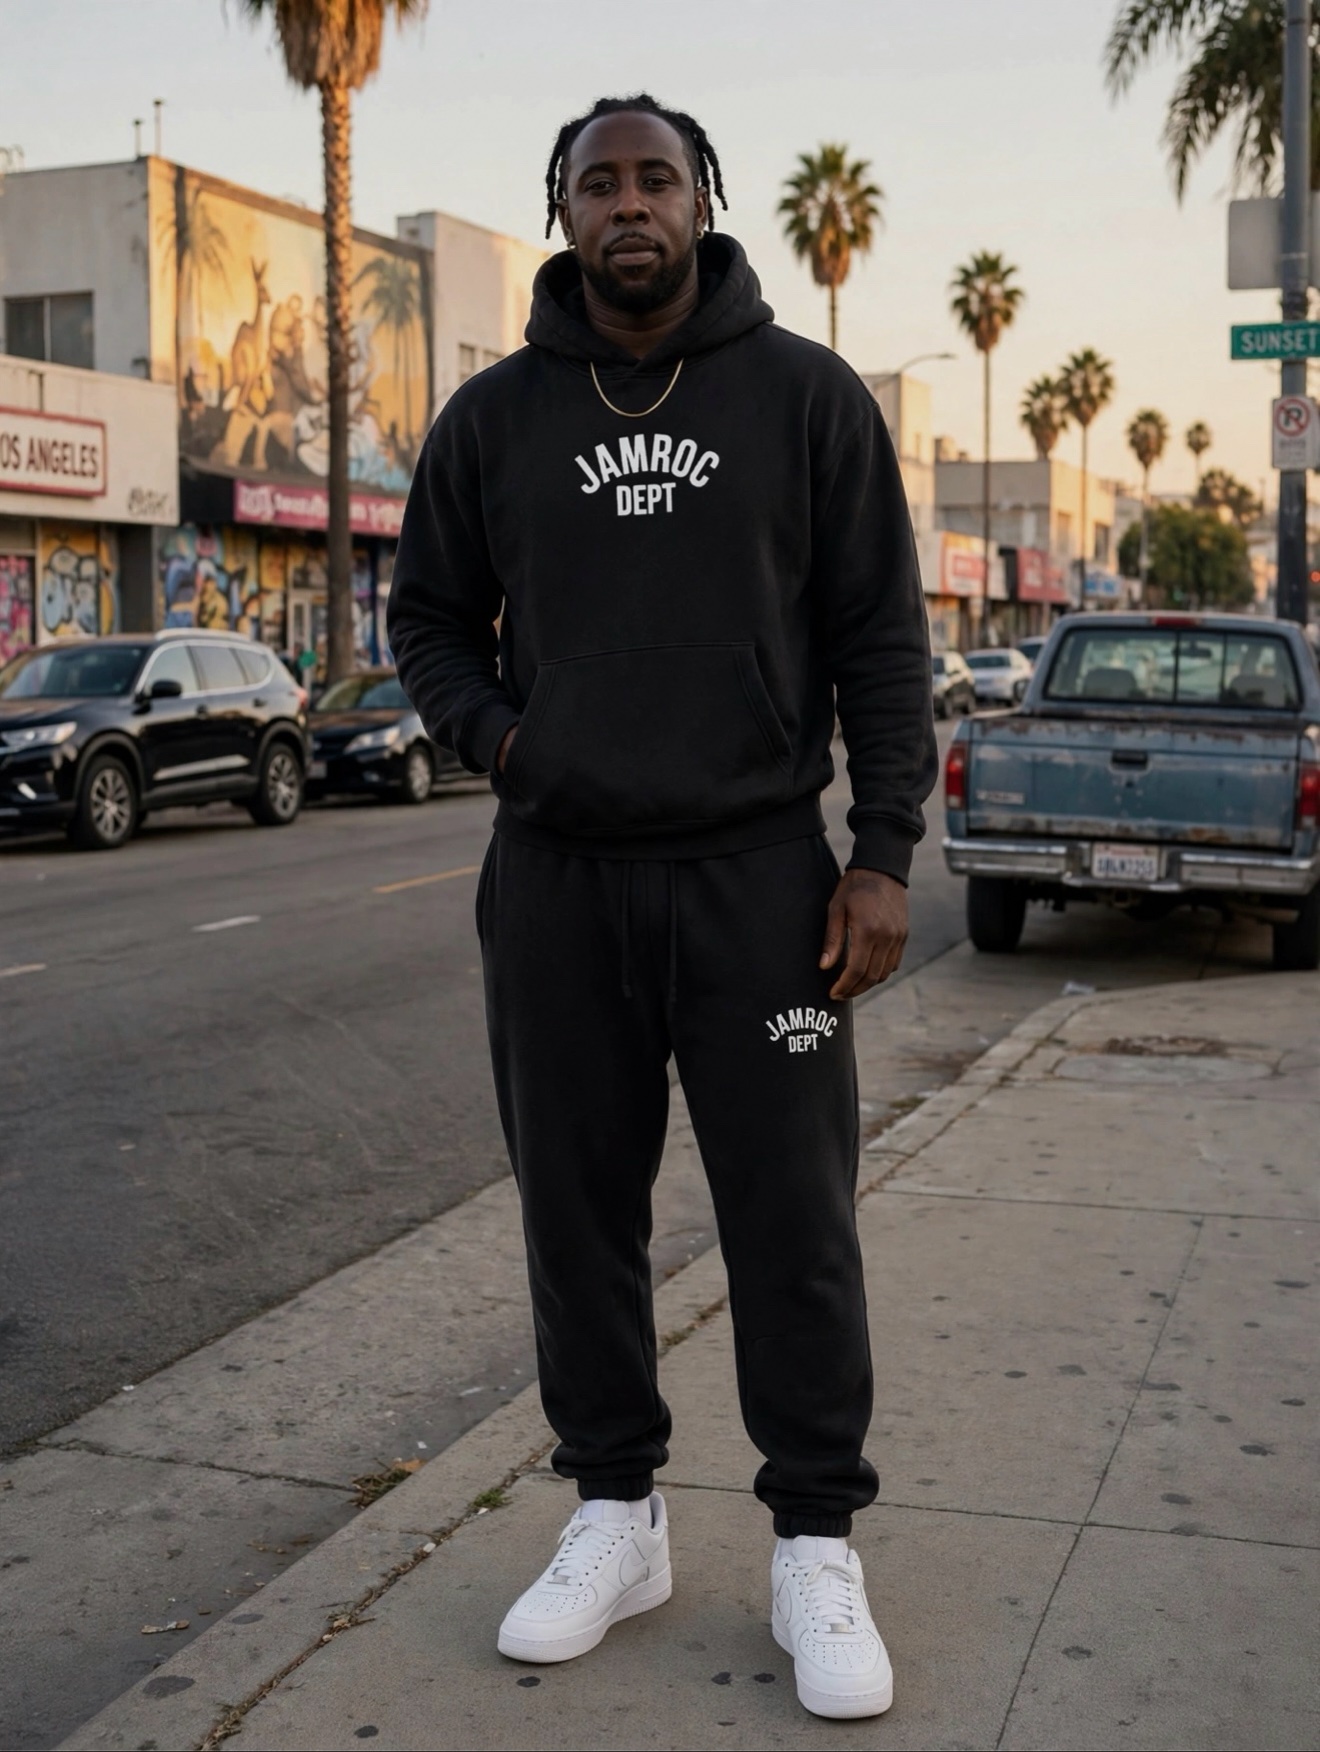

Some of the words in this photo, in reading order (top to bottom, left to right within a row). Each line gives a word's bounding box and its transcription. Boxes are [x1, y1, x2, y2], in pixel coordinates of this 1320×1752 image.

[1241, 328, 1319, 353] SUNSET
[26, 436, 98, 479] ANGELES
[574, 433, 720, 494] JAMROC
[616, 482, 676, 516] DEPT
[765, 1007, 838, 1042] JAMROC
[788, 1033, 818, 1053] DEPT
